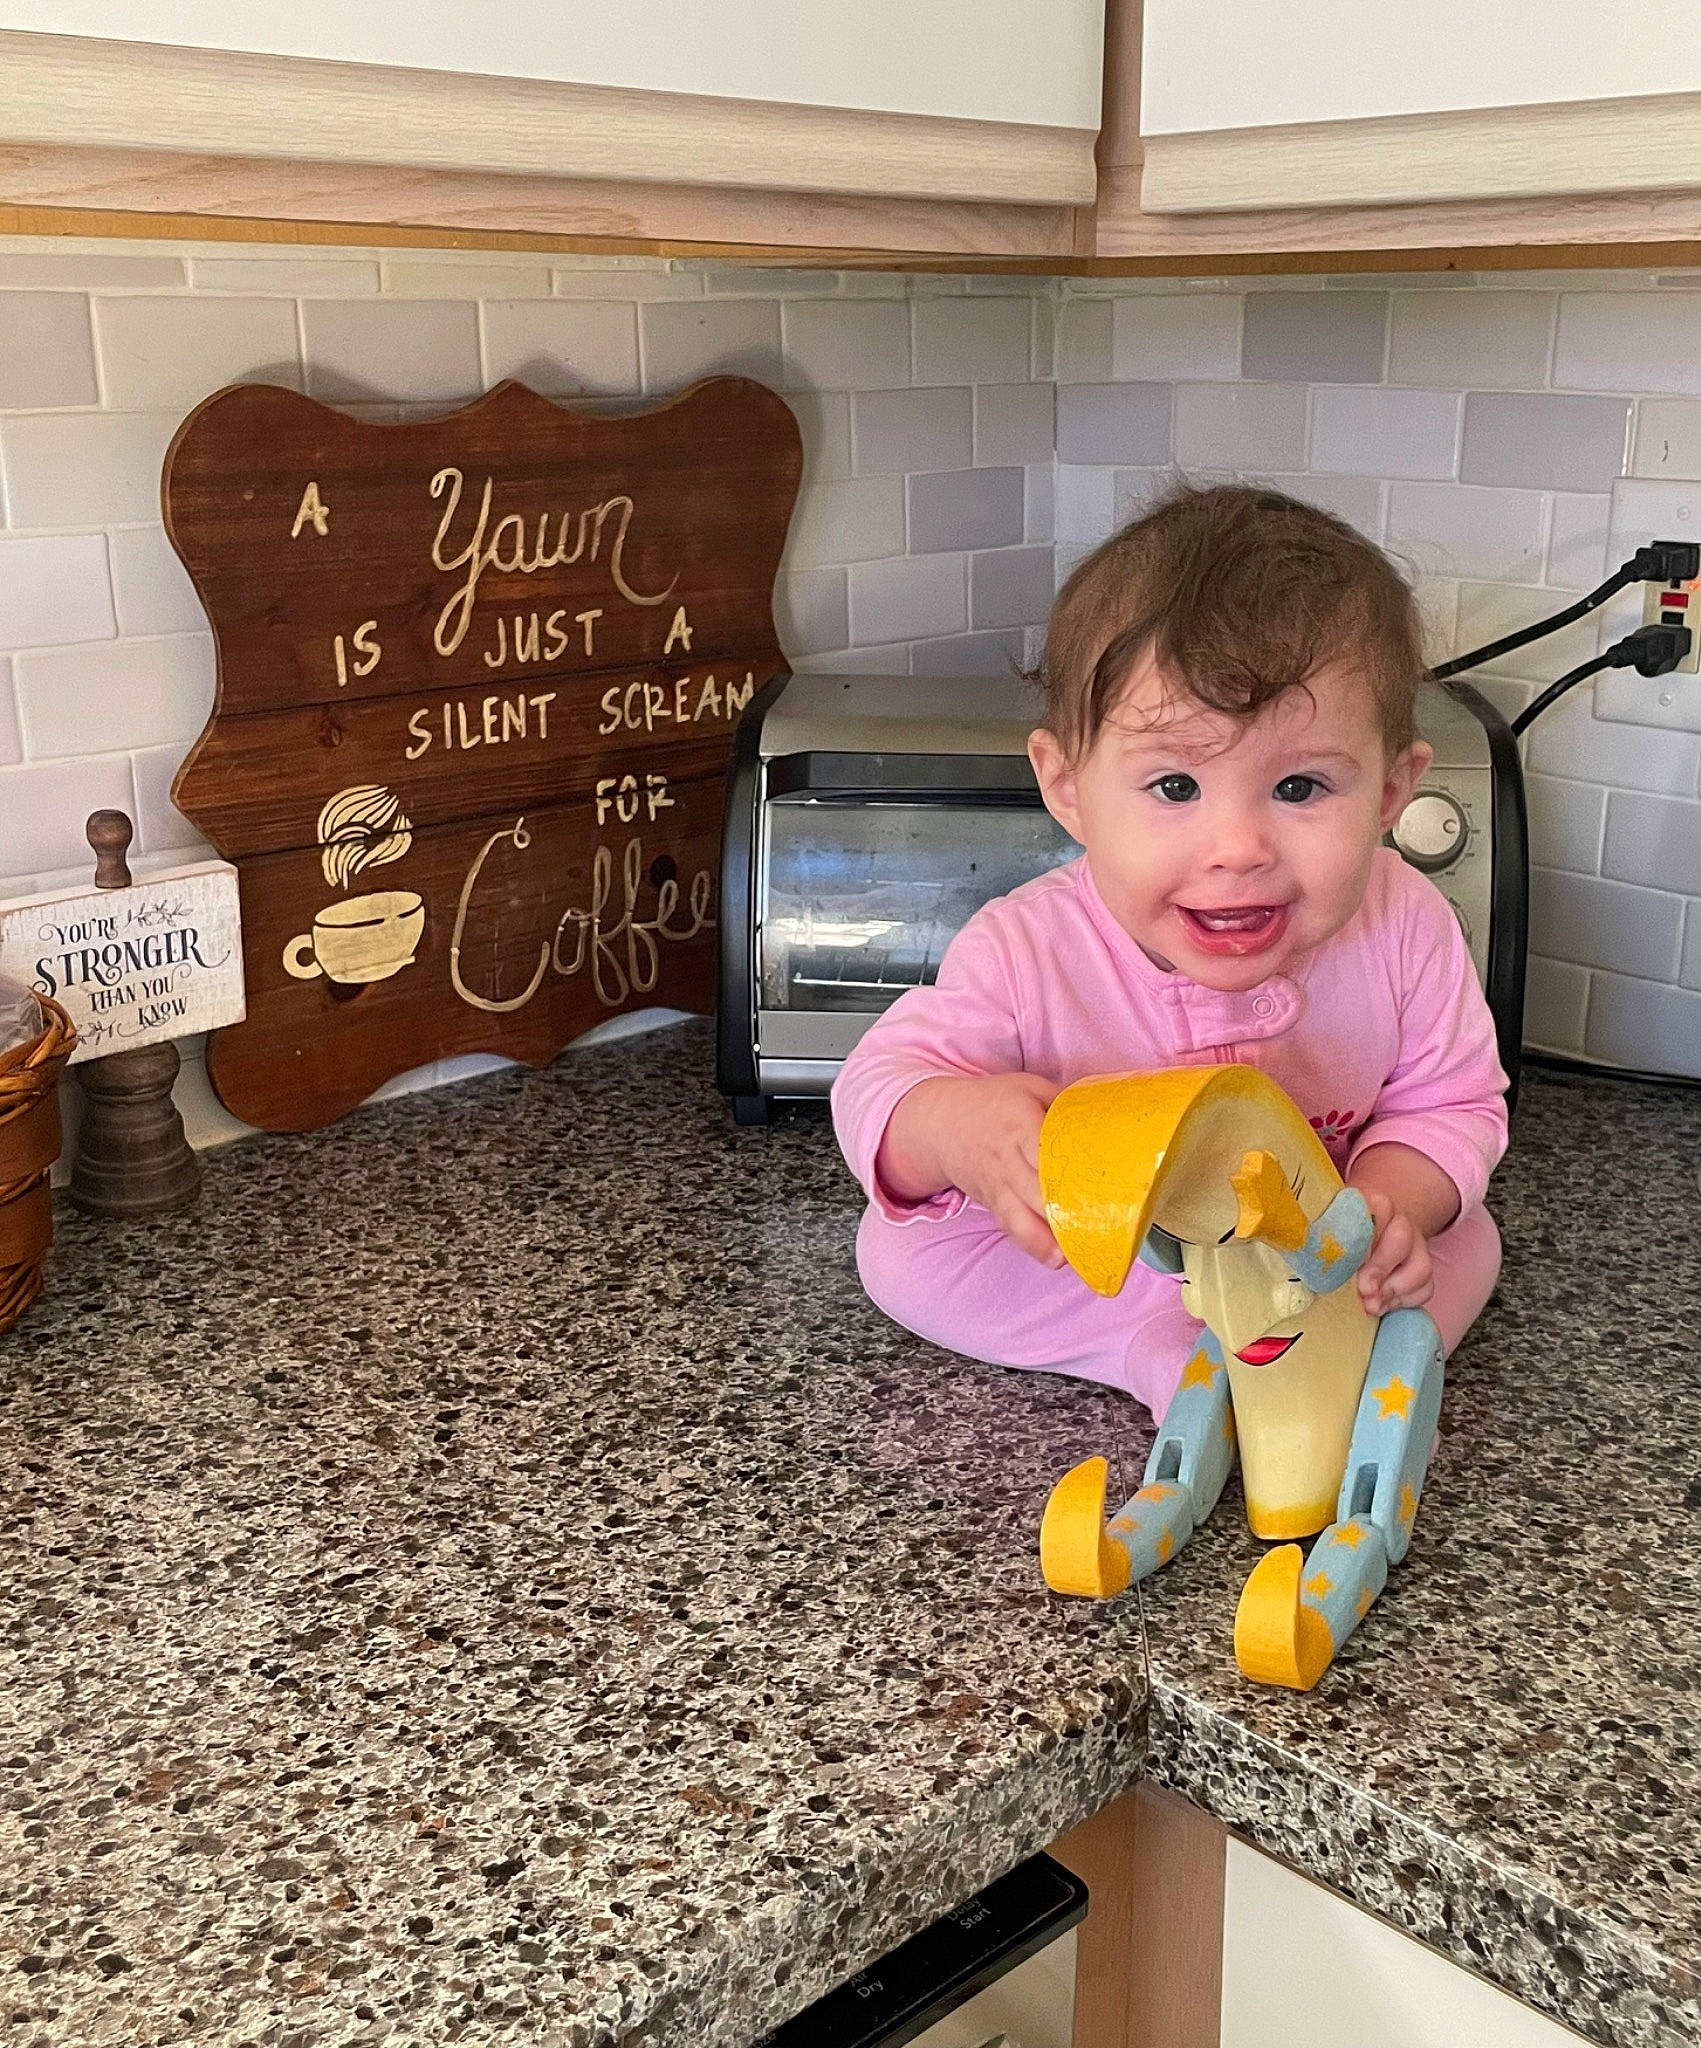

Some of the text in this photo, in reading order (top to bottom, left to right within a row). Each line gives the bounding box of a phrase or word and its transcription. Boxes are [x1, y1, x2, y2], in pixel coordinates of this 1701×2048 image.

[290, 466, 679, 657] A Yawn
[333, 604, 694, 687] IS JUST A
[405, 672, 755, 761] SILENT SCREAM
[595, 773, 676, 826] FOR
[38, 916, 119, 946] YOU'RE
[449, 815, 717, 1012] Coffee
[32, 927, 232, 998] STRONGER
[88, 962, 193, 1014] THAN YOU
[126, 996, 190, 1036] KNOW
[959, 1907, 992, 1930] Start
[856, 1980, 884, 1998] Dry
